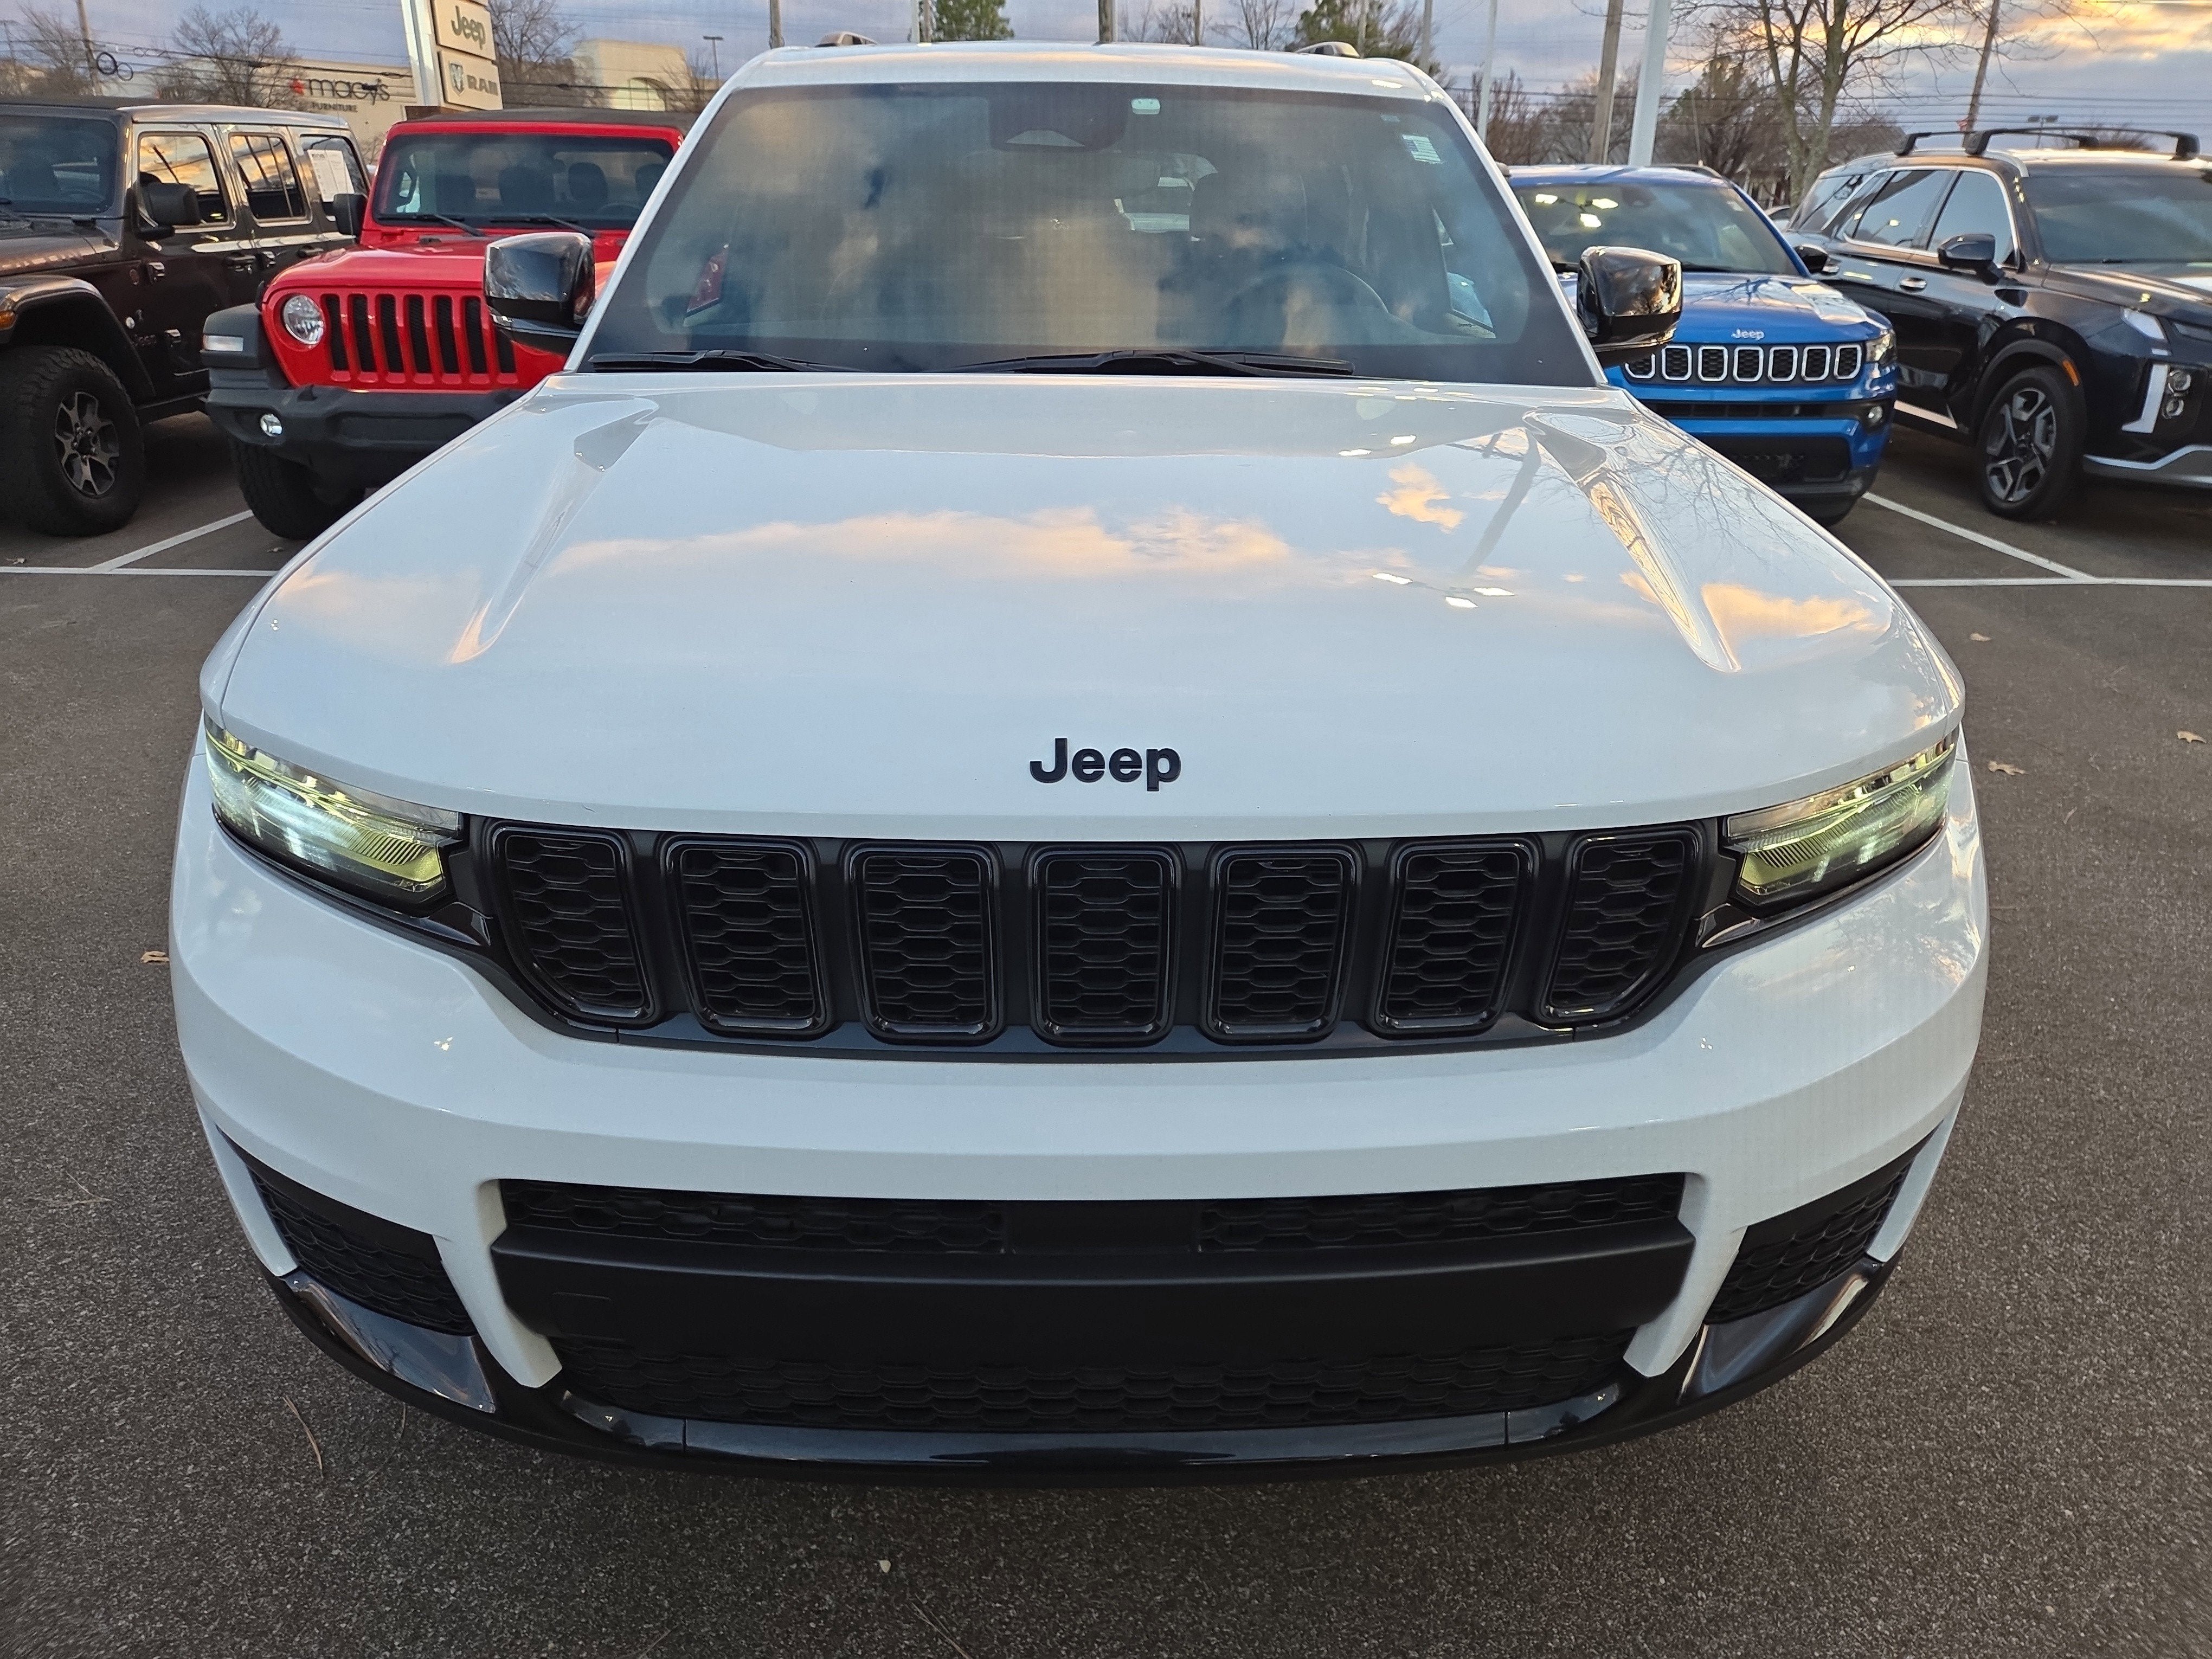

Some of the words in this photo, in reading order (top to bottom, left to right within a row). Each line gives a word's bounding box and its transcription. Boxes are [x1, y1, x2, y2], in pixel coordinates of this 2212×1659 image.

[451, 5, 486, 50] Jeep
[467, 75, 498, 96] RAM
[1731, 328, 1765, 341] Jeep
[1030, 737, 1181, 792] Jeep
